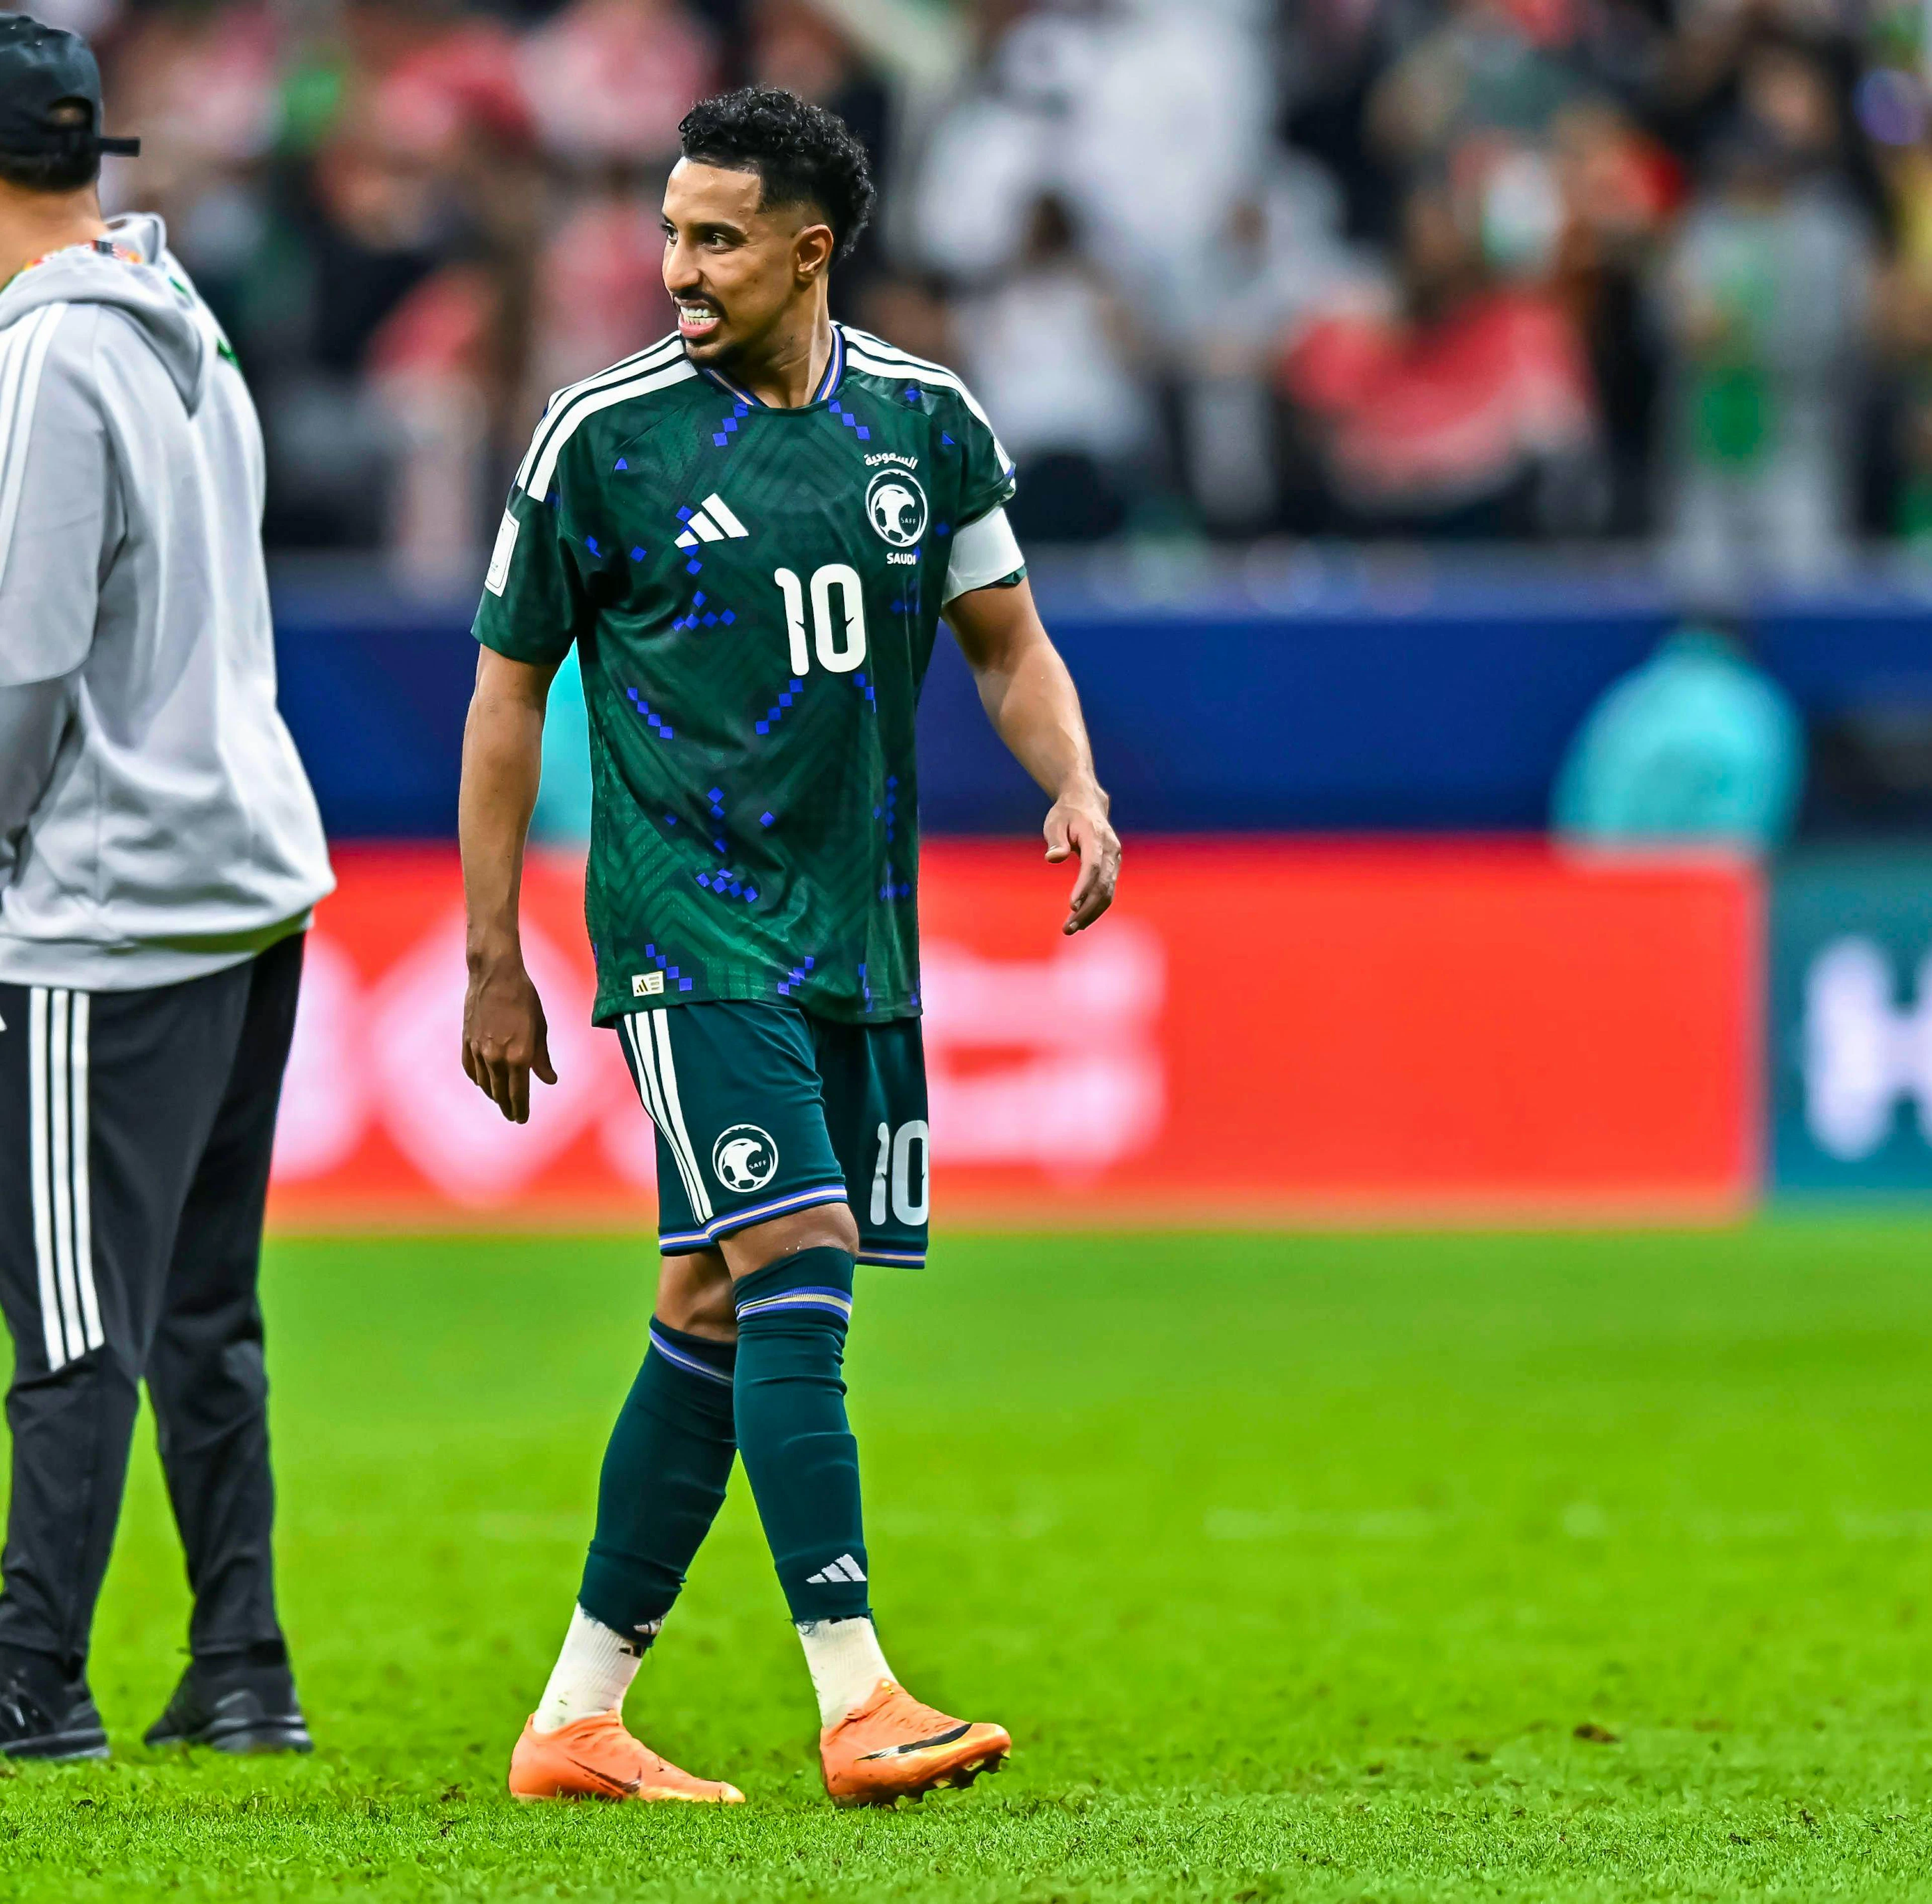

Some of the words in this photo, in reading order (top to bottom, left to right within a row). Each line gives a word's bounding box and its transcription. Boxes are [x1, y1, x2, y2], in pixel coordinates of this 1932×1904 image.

[864, 453, 918, 469] السعودية
[886, 552, 917, 565] SAUDI
[774, 563, 866, 676] 10
[748, 1160, 767, 1170] SAFF
[870, 1120, 929, 1226] 10
